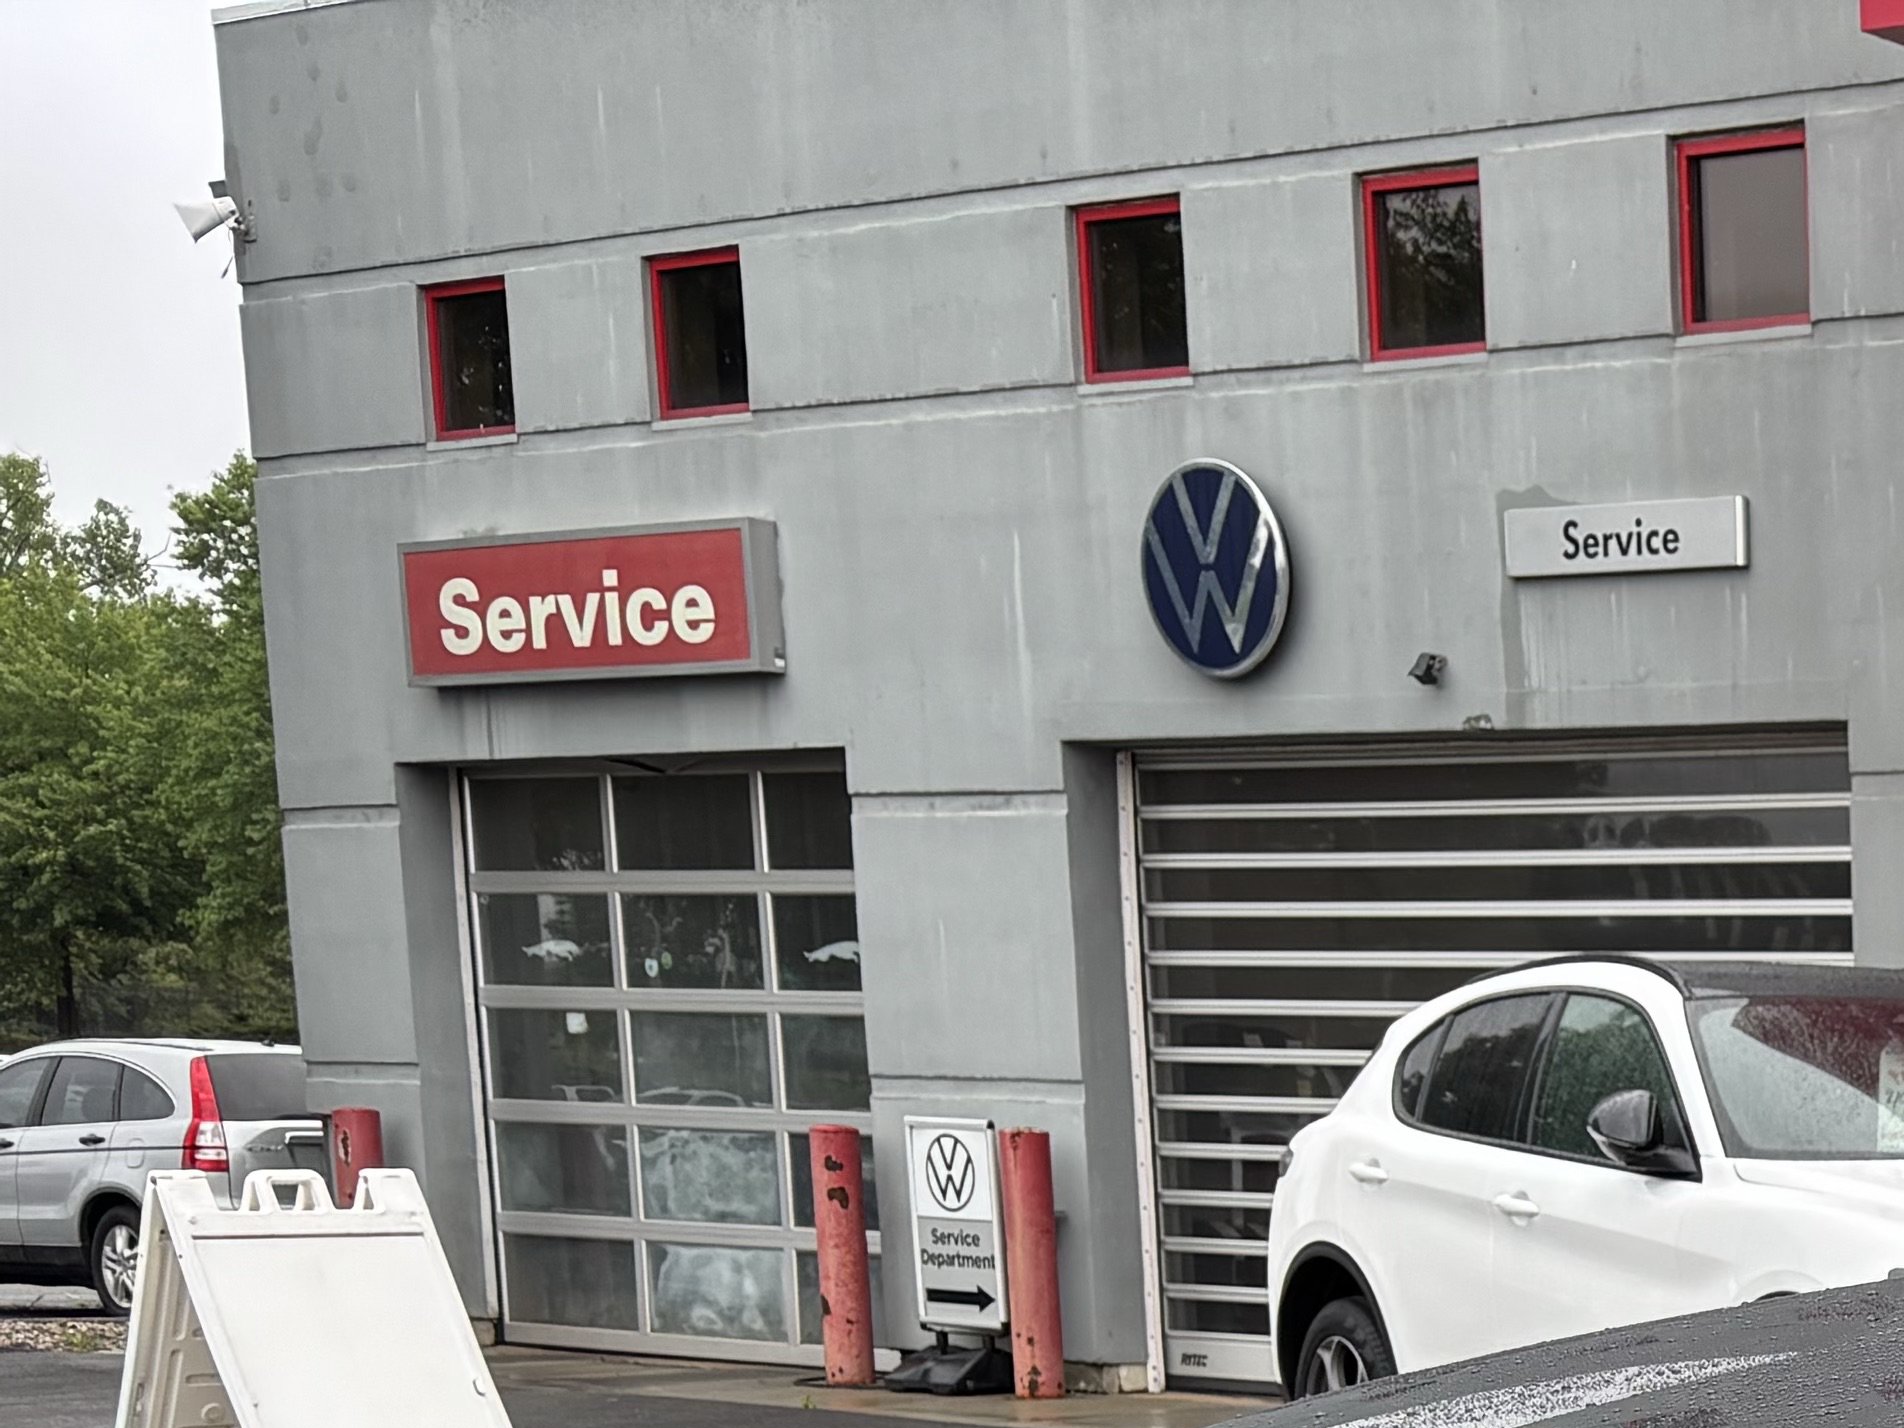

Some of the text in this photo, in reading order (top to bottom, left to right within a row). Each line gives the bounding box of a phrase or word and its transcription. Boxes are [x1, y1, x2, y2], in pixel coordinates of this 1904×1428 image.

[1563, 517, 1680, 560] Service
[439, 569, 716, 656] Service
[931, 1227, 981, 1248] Service
[921, 1248, 996, 1270] Department
